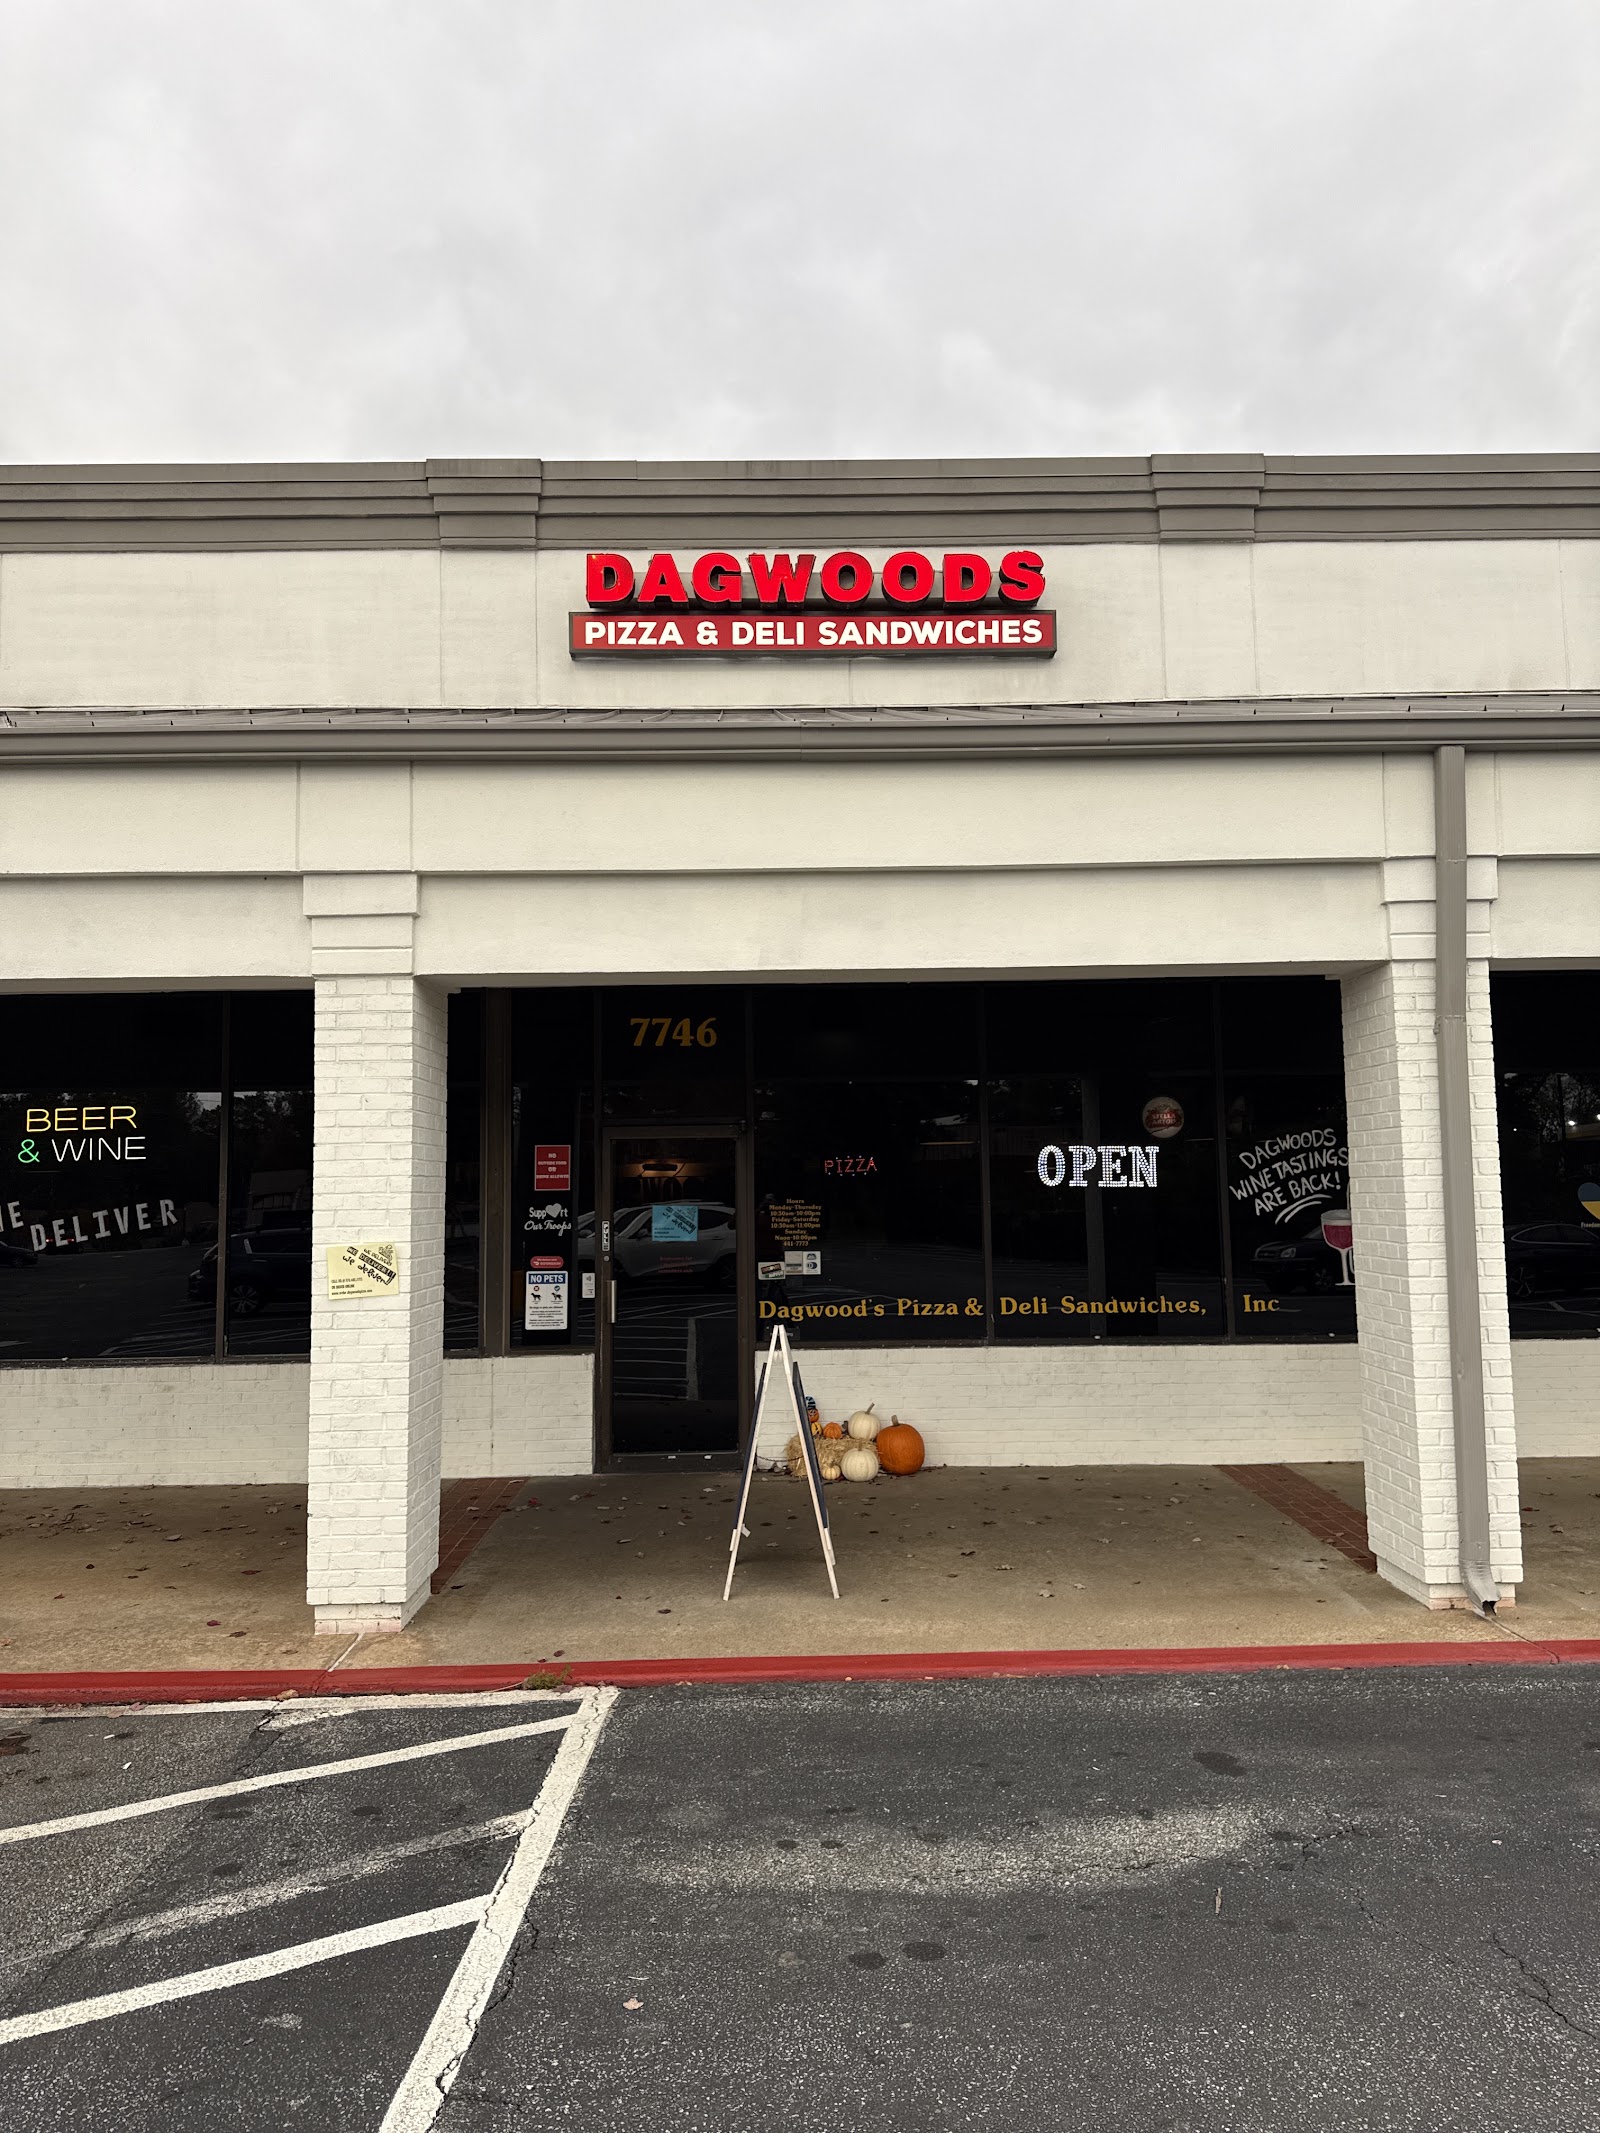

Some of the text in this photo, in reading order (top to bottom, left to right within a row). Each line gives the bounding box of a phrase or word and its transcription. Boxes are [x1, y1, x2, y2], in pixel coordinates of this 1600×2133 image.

[586, 550, 1046, 606] DAGWOODS
[584, 619, 1043, 645] PIZZA & DELI SANDWICHES
[630, 1017, 717, 1047] 7746
[26, 1105, 137, 1132] BEER
[17, 1136, 146, 1163] & WINE
[1238, 1128, 1336, 1170] DAGWOODS
[824, 1156, 878, 1176] PIZZA
[1036, 1145, 1160, 1187] OPEN
[1229, 1147, 1349, 1200] WINE TASTINGS
[1254, 1171, 1341, 1216] ARE BACK!
[30, 1199, 178, 1252] DELIVER
[524, 1219, 572, 1237] Our Troops
[530, 1274, 564, 1283] NO PETS
[758, 1294, 1280, 1321] Dagwood's Pizza & Deli Sandwiches, Inc
